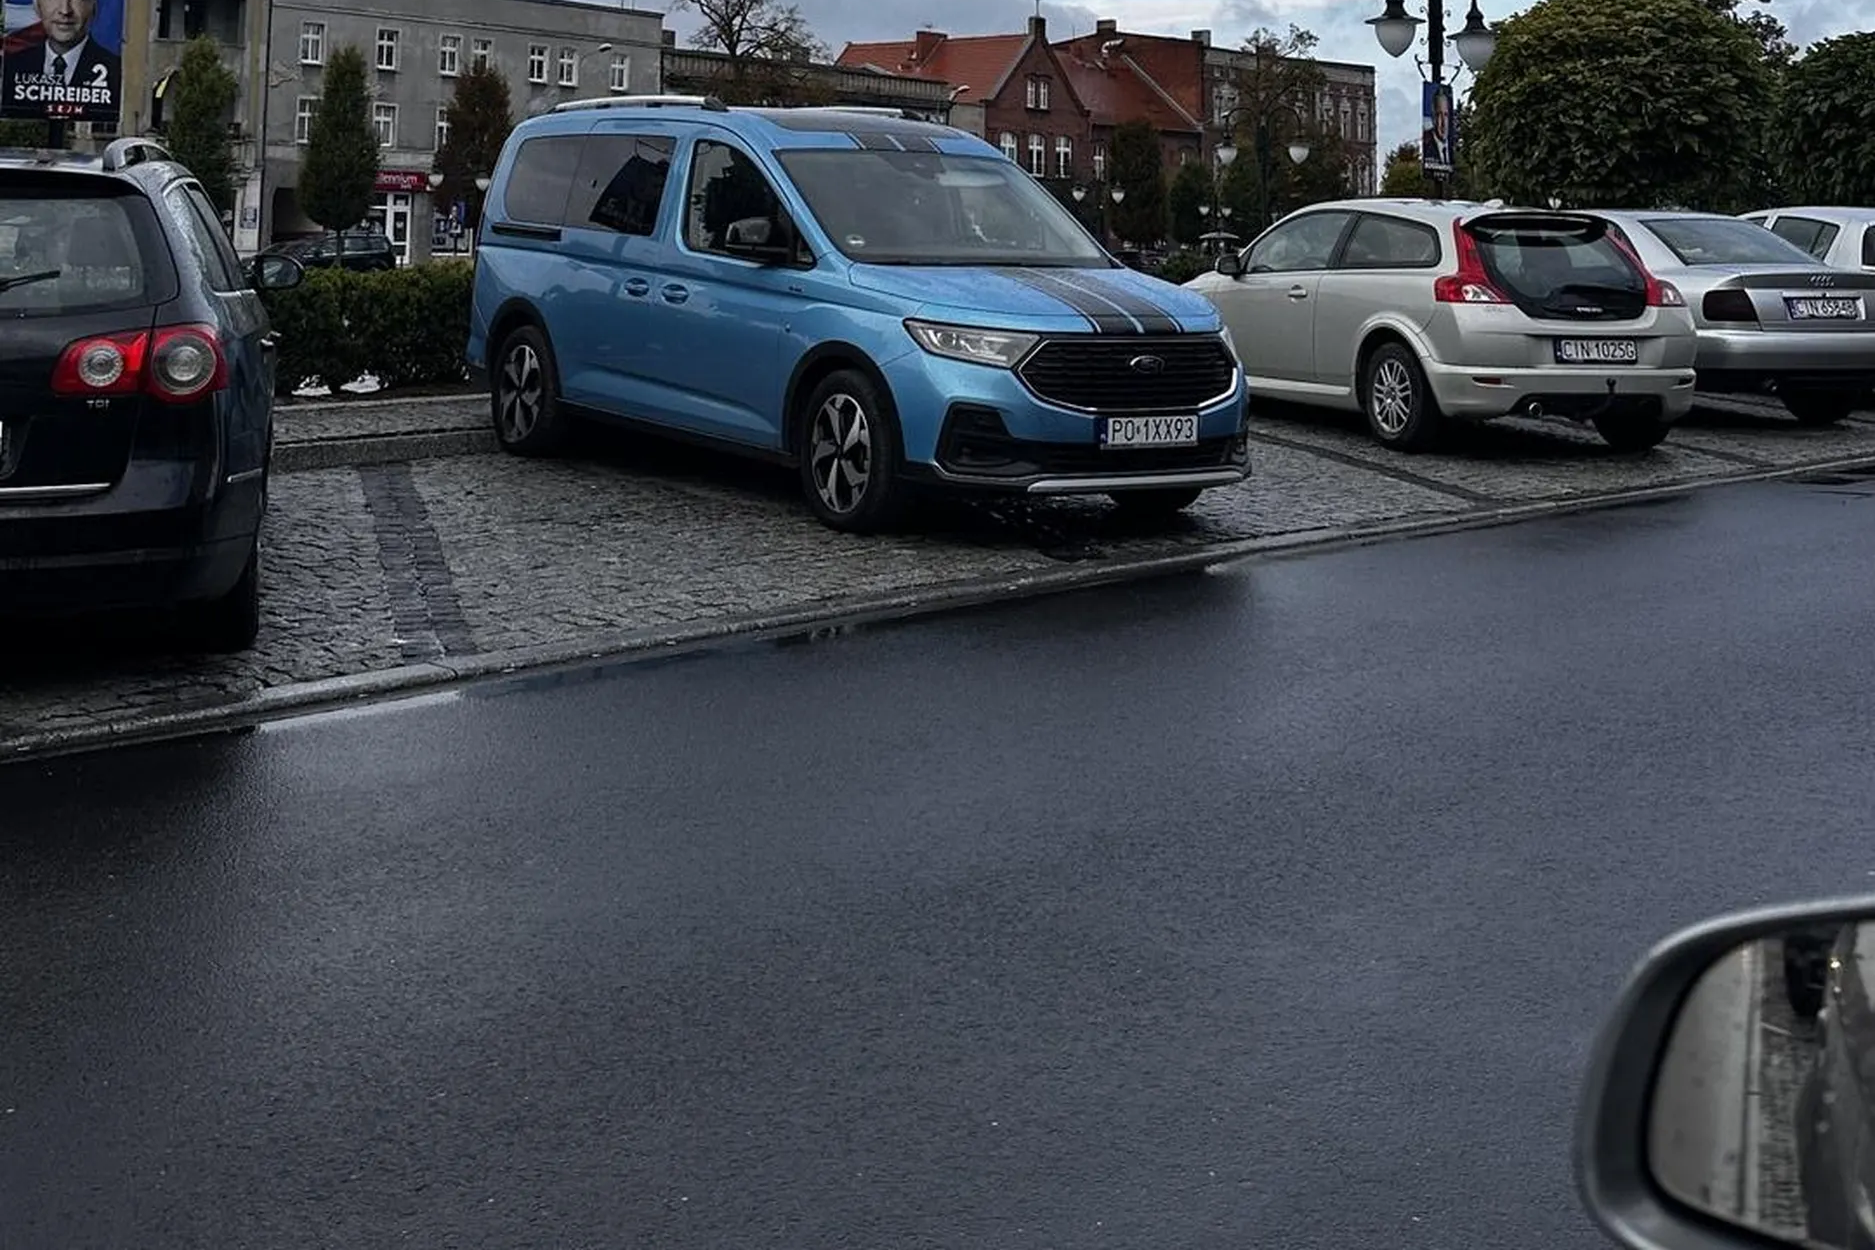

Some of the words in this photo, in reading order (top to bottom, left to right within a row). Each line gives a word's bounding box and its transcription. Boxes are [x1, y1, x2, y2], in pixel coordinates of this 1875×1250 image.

[91, 63, 109, 87] 2
[14, 85, 112, 104] SCHREIBER
[1563, 341, 1591, 358] CIN
[86, 398, 110, 410] TDI
[1112, 419, 1135, 442] PO
[1143, 417, 1194, 442] 1XX93
